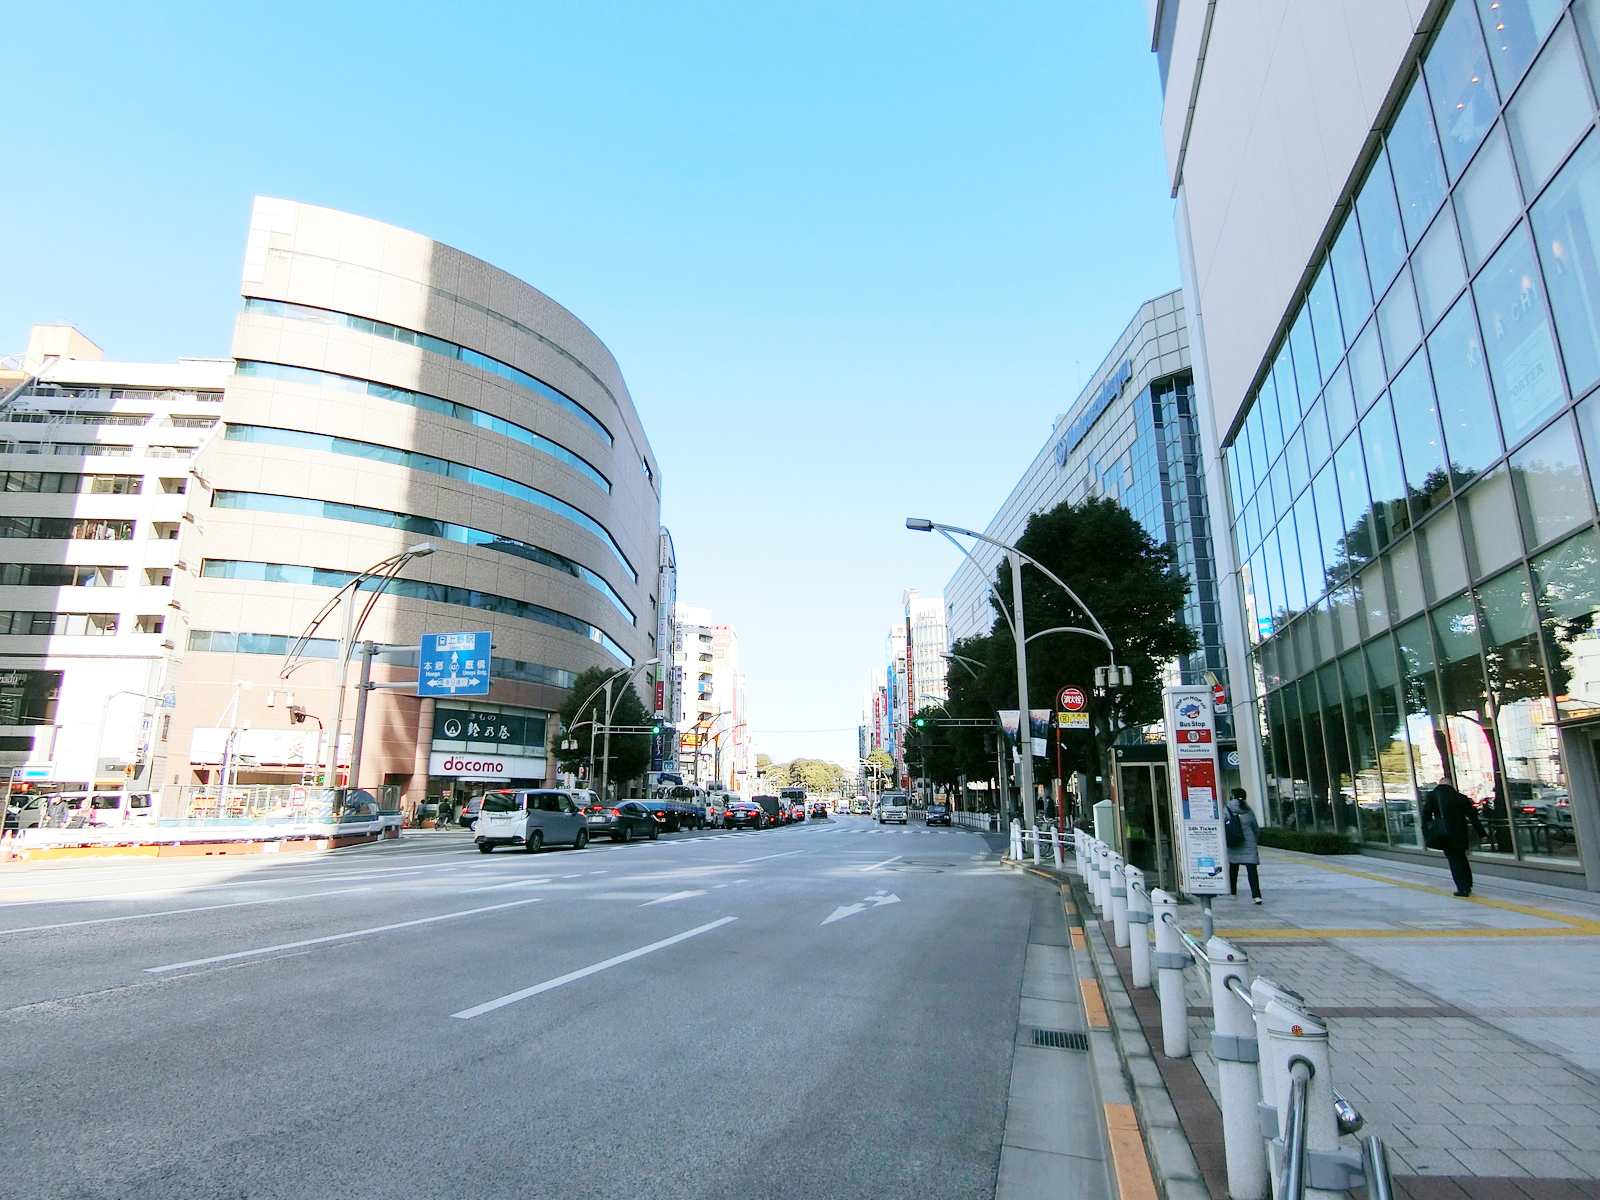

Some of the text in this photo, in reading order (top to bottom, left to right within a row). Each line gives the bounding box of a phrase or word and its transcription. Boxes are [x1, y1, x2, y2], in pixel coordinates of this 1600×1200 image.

[448, 634, 475, 645] 上野駅
[1063, 695, 1082, 704] 消火栓
[469, 712, 497, 722] きもの
[443, 756, 504, 773] docomo
